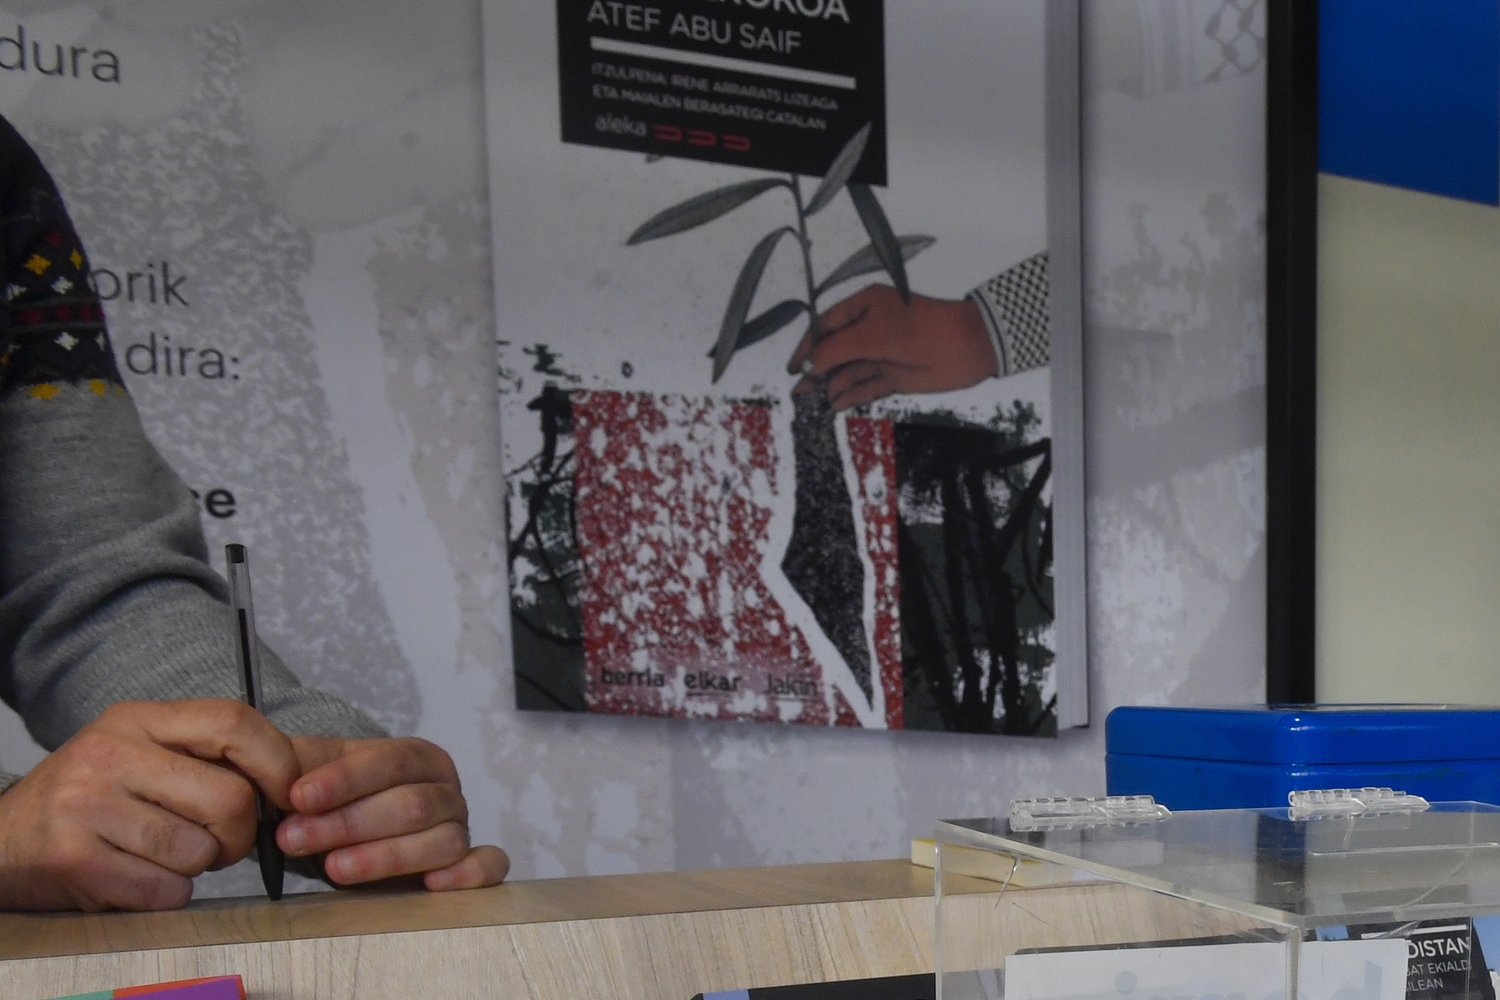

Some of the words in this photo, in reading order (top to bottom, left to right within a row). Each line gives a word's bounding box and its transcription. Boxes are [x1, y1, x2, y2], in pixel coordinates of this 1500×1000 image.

[587, 2, 661, 33] ATEF
[670, 12, 731, 44] ABU
[739, 23, 801, 54] SAIF
[595, 112, 647, 138] aleka
[125, 332, 241, 381] dira:
[601, 666, 664, 688] berria
[684, 671, 740, 693] elkar
